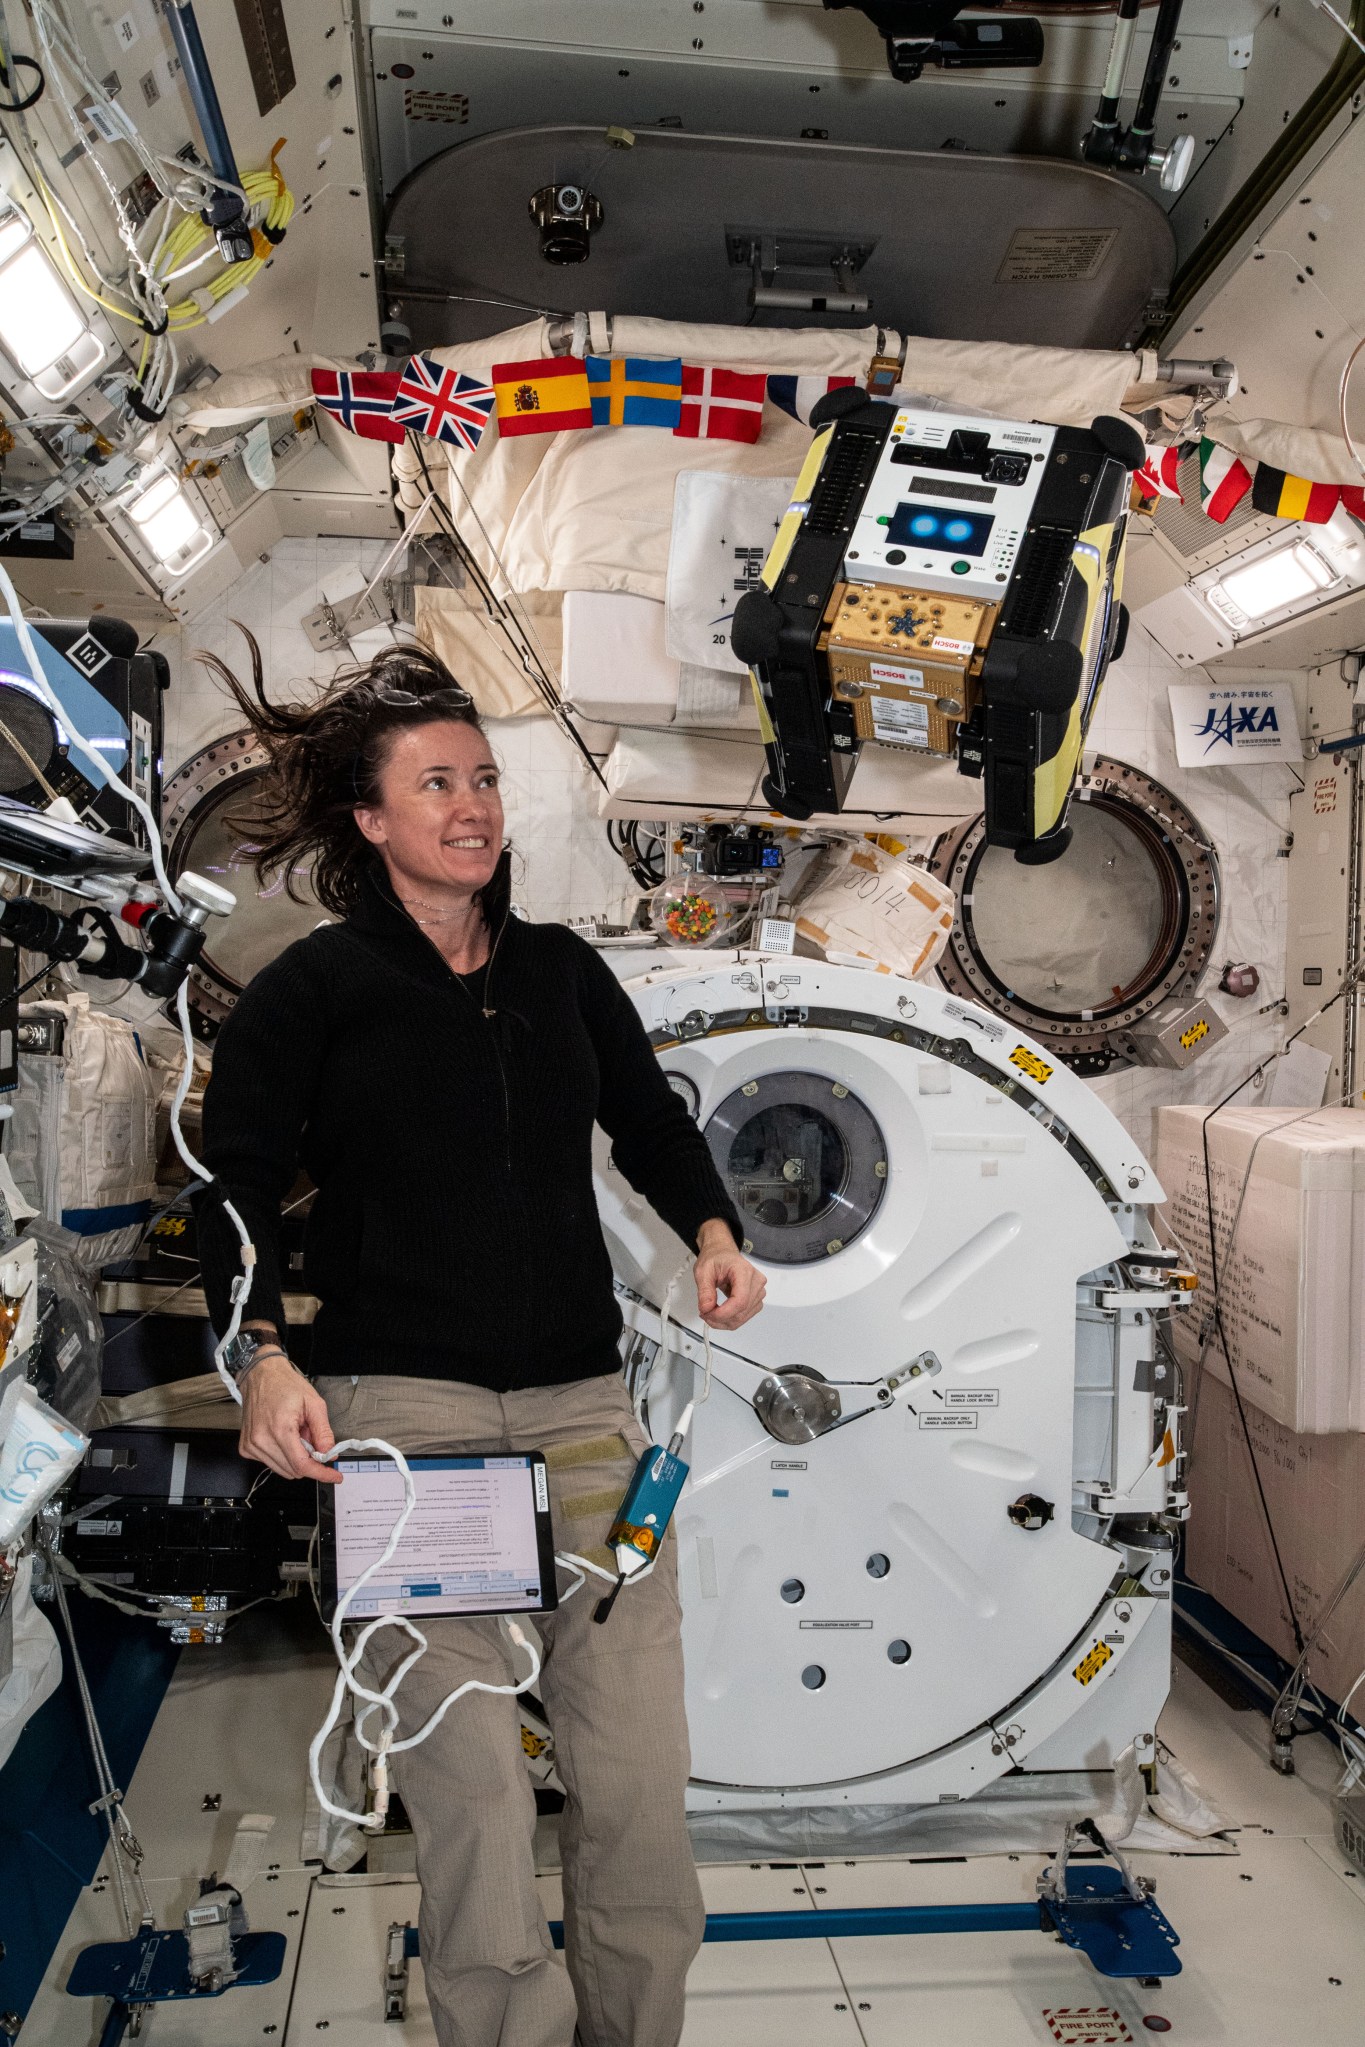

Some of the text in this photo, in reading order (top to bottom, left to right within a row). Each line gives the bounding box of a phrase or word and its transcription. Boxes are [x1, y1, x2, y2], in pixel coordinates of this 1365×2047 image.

[413, 102, 433, 110] FIRE
[712, 634, 726, 644] 20
[934, 639, 960, 650] BOSCH
[872, 668, 906, 681] BOSCH
[1192, 702, 1279, 749] JAXA
[1019, 1051, 1036, 1065] CAUTION
[537, 1466, 547, 1511] MEGAN MSL
